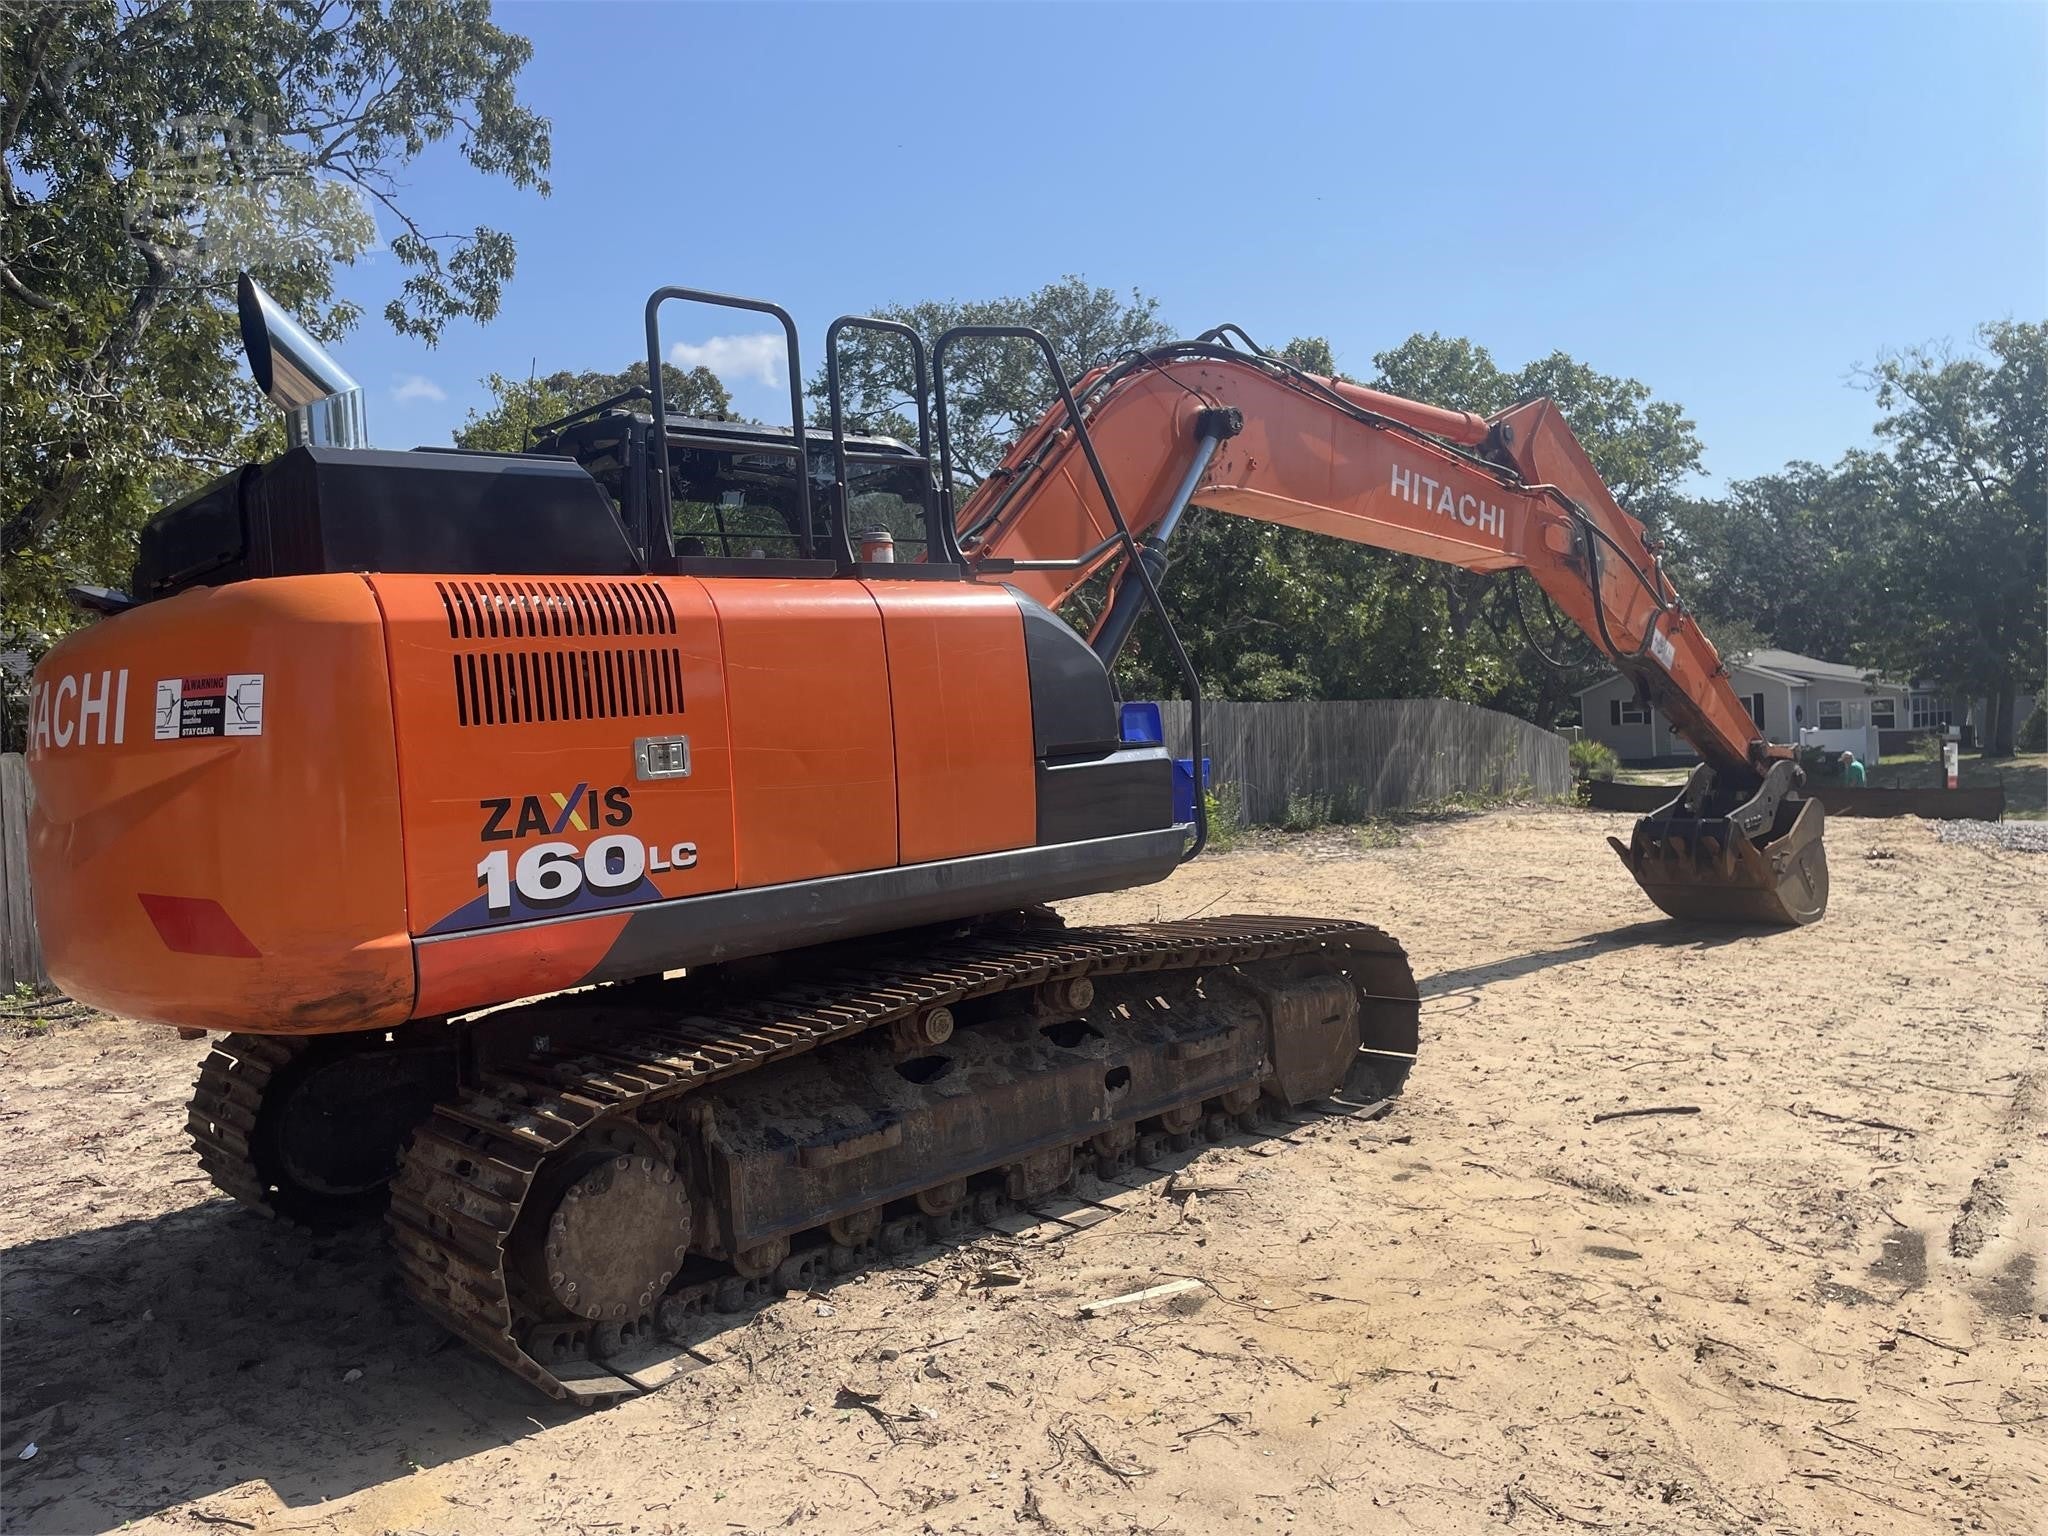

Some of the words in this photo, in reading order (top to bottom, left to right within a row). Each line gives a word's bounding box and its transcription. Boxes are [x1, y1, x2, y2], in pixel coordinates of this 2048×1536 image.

[1391, 464, 1505, 538] HITACHI
[191, 678, 224, 691] WARNING
[183, 699, 203, 708] Operator
[203, 699, 214, 707] may
[202, 707, 221, 715] reverse
[182, 728, 196, 736] STAY
[197, 727, 215, 735] CLEAR
[480, 783, 633, 842] ZAXIS
